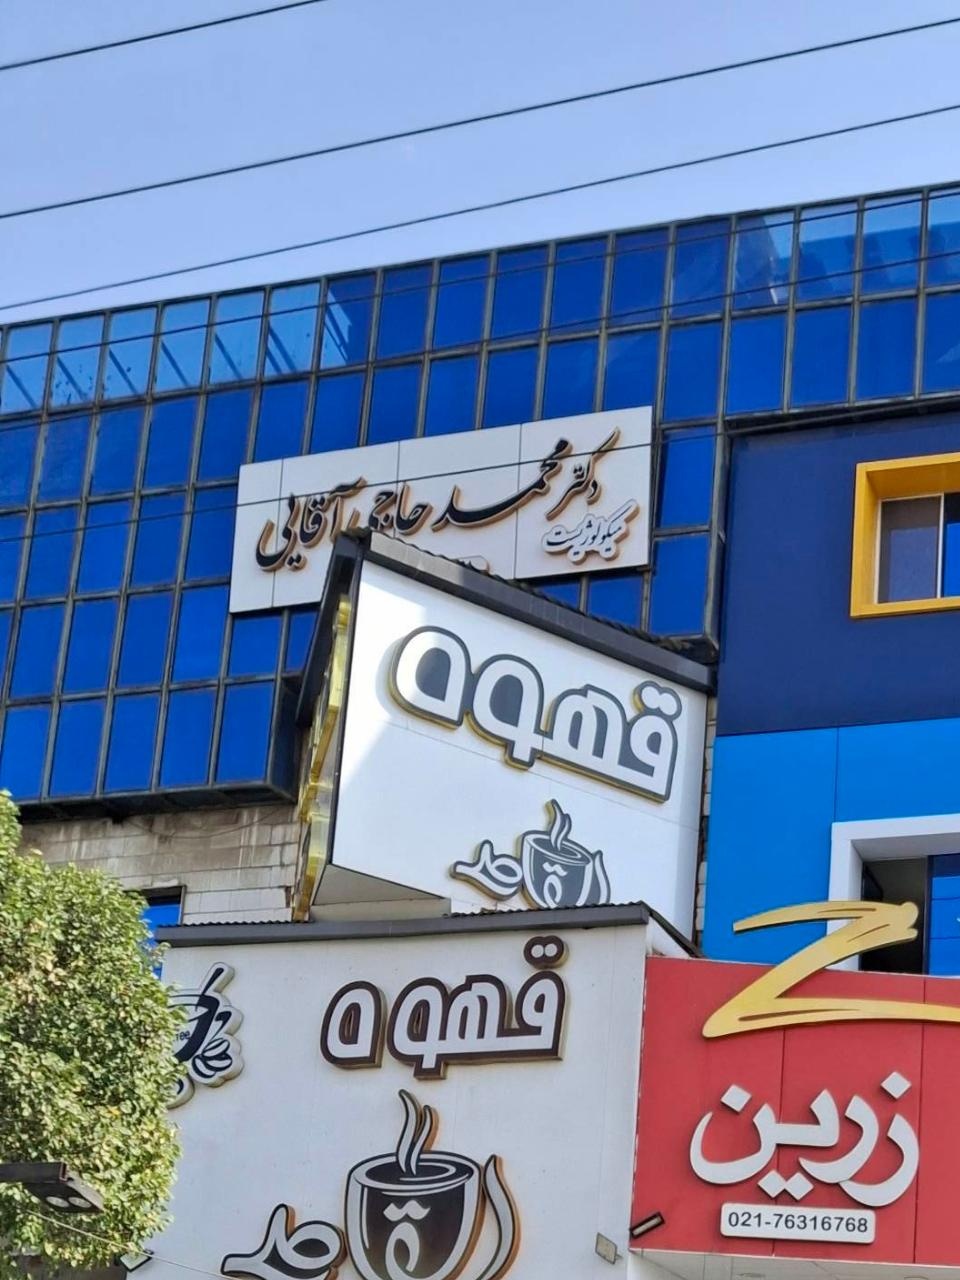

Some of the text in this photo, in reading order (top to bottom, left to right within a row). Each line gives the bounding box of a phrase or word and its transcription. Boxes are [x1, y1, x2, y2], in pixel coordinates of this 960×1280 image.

[431, 438, 572, 532] محمد
[545, 427, 620, 520] دکتر
[389, 624, 683, 802] قهوه
[320, 936, 566, 1079] قهوه
[690, 1071, 920, 1207] زرین
[728, 1211, 868, 1233] 021-76316768
